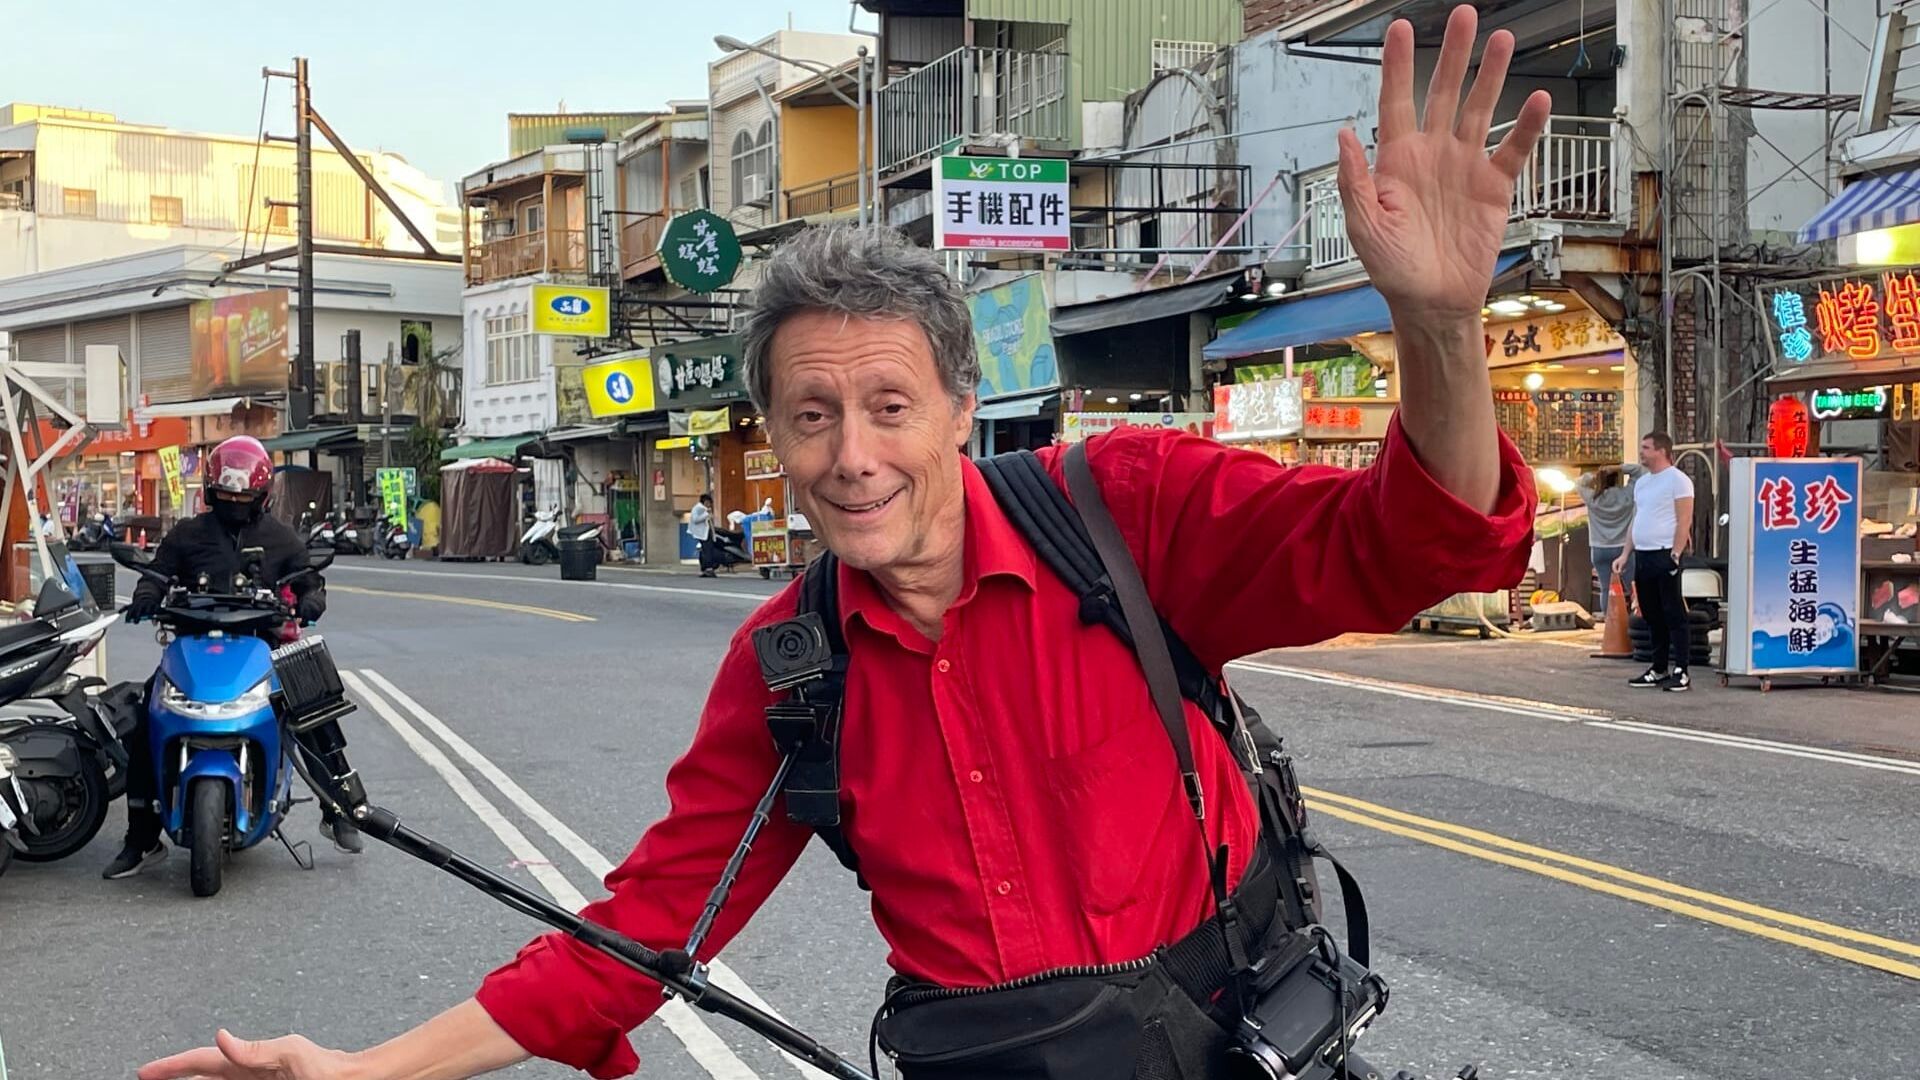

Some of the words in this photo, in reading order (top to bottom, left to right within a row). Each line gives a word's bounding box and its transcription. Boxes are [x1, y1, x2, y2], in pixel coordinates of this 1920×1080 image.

[998, 163, 1042, 179] TOP
[947, 191, 1065, 226] 手機配件
[1502, 324, 1541, 358] 台式
[1774, 291, 1813, 361] 佳珍
[1854, 393, 1882, 407] BEER
[1760, 477, 1851, 532] 佳珍
[1789, 540, 1818, 652] 生猛海鮮
